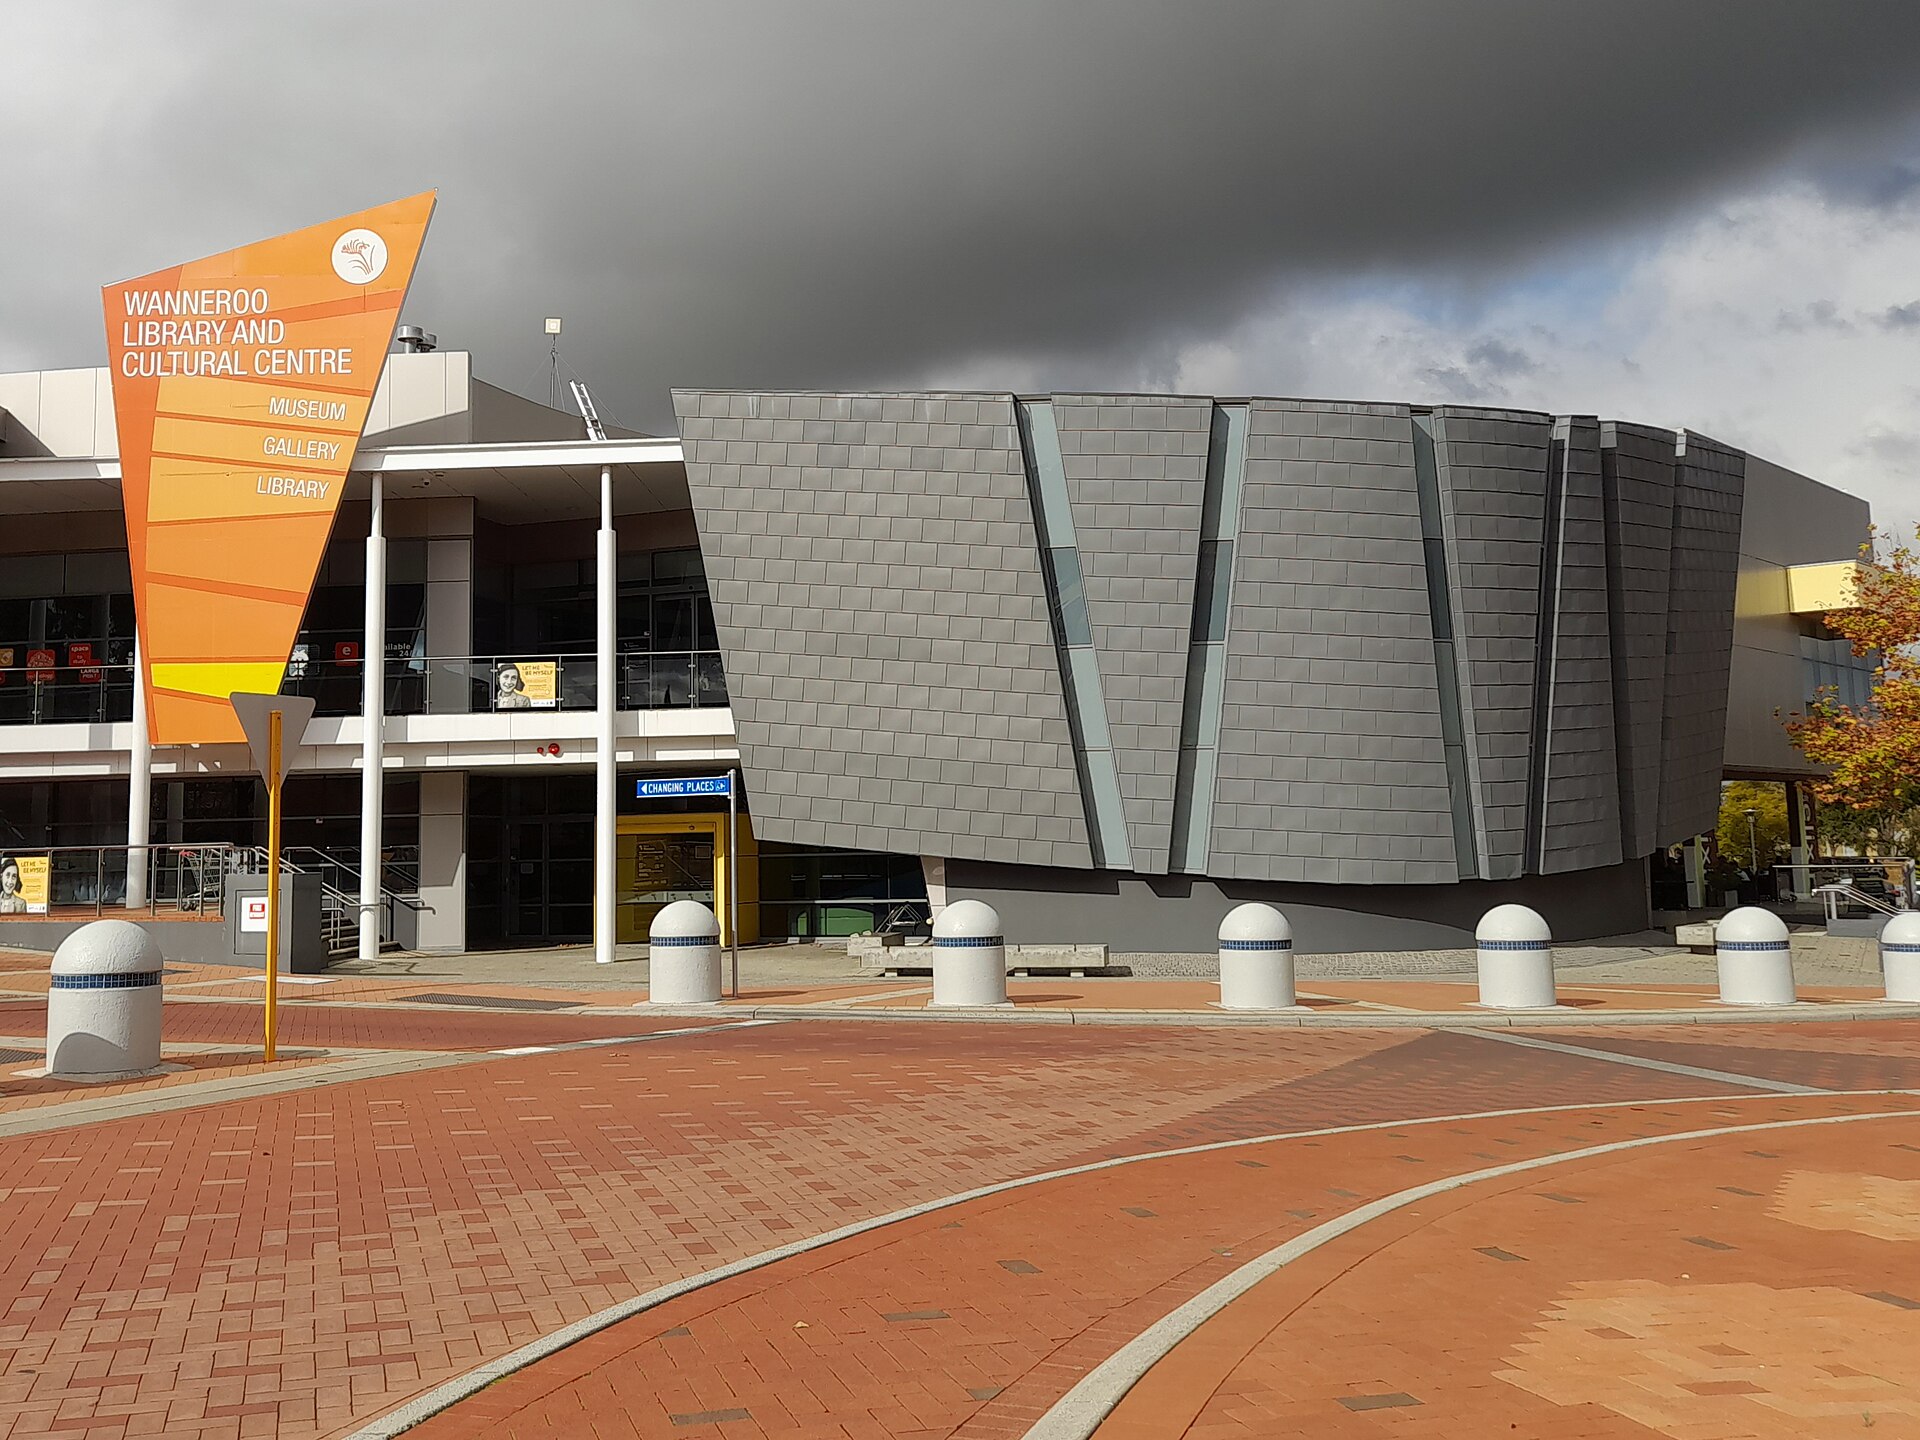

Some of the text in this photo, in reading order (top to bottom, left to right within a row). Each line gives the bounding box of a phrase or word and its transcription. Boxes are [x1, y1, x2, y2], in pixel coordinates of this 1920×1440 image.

[123, 288, 268, 316] WANNEROO
[123, 319, 285, 346] LIBRARY AND
[122, 348, 352, 377] CULTURAL CENTRE
[268, 397, 346, 421] MUSEUM
[263, 436, 340, 460] GALLERY
[256, 476, 329, 499] LIBRARY
[648, 781, 714, 794] CHANGING PLACES
